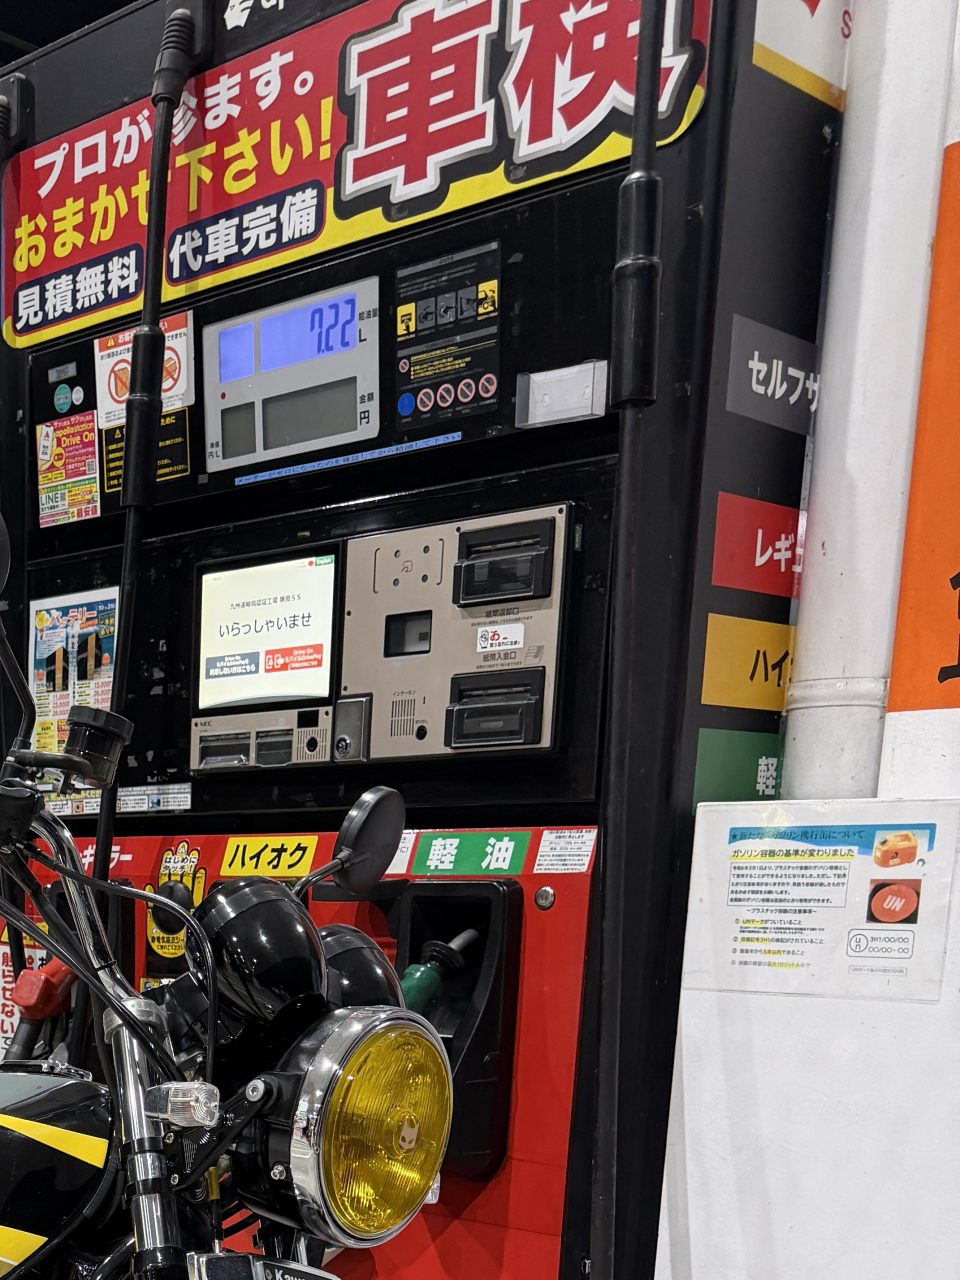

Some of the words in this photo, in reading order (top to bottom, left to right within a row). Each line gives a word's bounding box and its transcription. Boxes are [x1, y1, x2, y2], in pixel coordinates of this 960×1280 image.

[169, 188, 318, 279] 代車完備
[15, 251, 138, 329] 見積無料
[358, 328, 368, 343] L
[359, 410, 370, 426] 円
[61, 436, 81, 448] Drive
[82, 431, 95, 442] On
[40, 492, 60, 507] LINE
[219, 612, 312, 638] いらっしゃいませ
[749, 648, 793, 687] ハイ
[164, 856, 198, 864] はじめに
[228, 842, 309, 870] ハイオク
[426, 838, 515, 870] 軽油
[883, 895, 906, 911] UN
